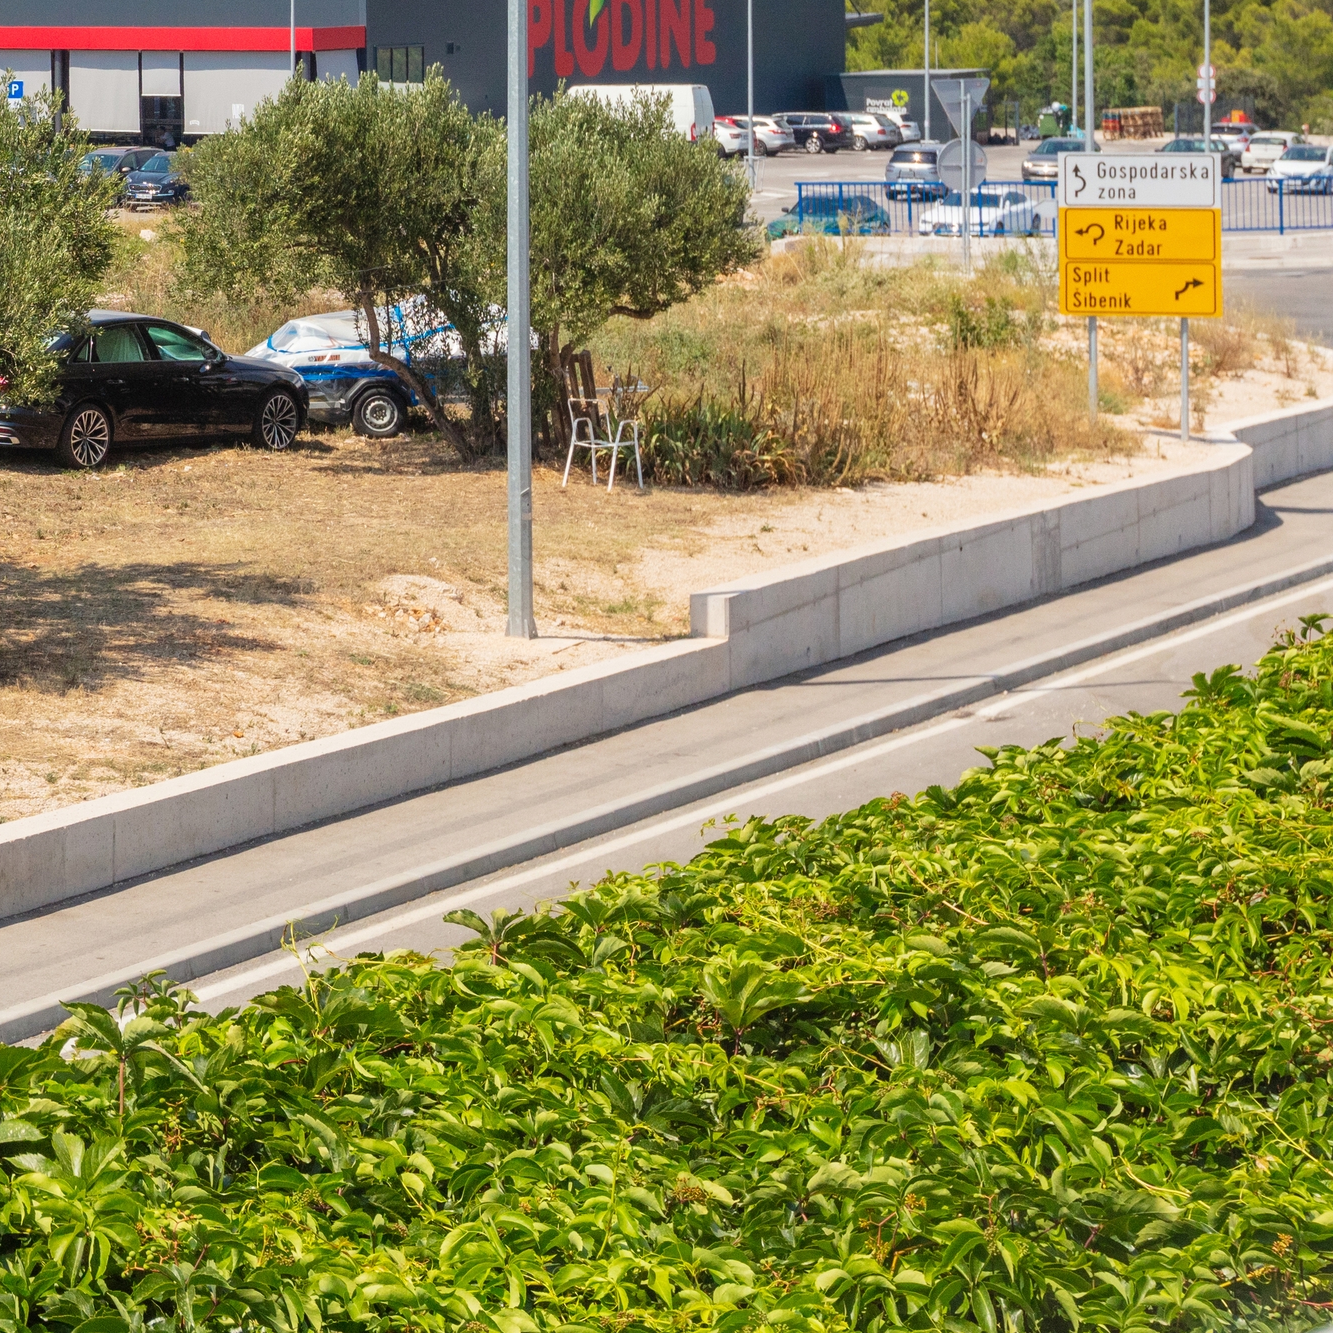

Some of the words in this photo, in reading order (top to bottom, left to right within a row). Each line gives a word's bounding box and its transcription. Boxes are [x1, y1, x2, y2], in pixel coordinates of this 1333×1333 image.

[1097, 161, 1209, 183] Gospodarska
[1098, 187, 1136, 199] zona
[1114, 214, 1167, 234] Rijeka
[1115, 240, 1162, 256] Zadar
[1073, 267, 1110, 285] Split
[1073, 288, 1131, 308] Šibenik
